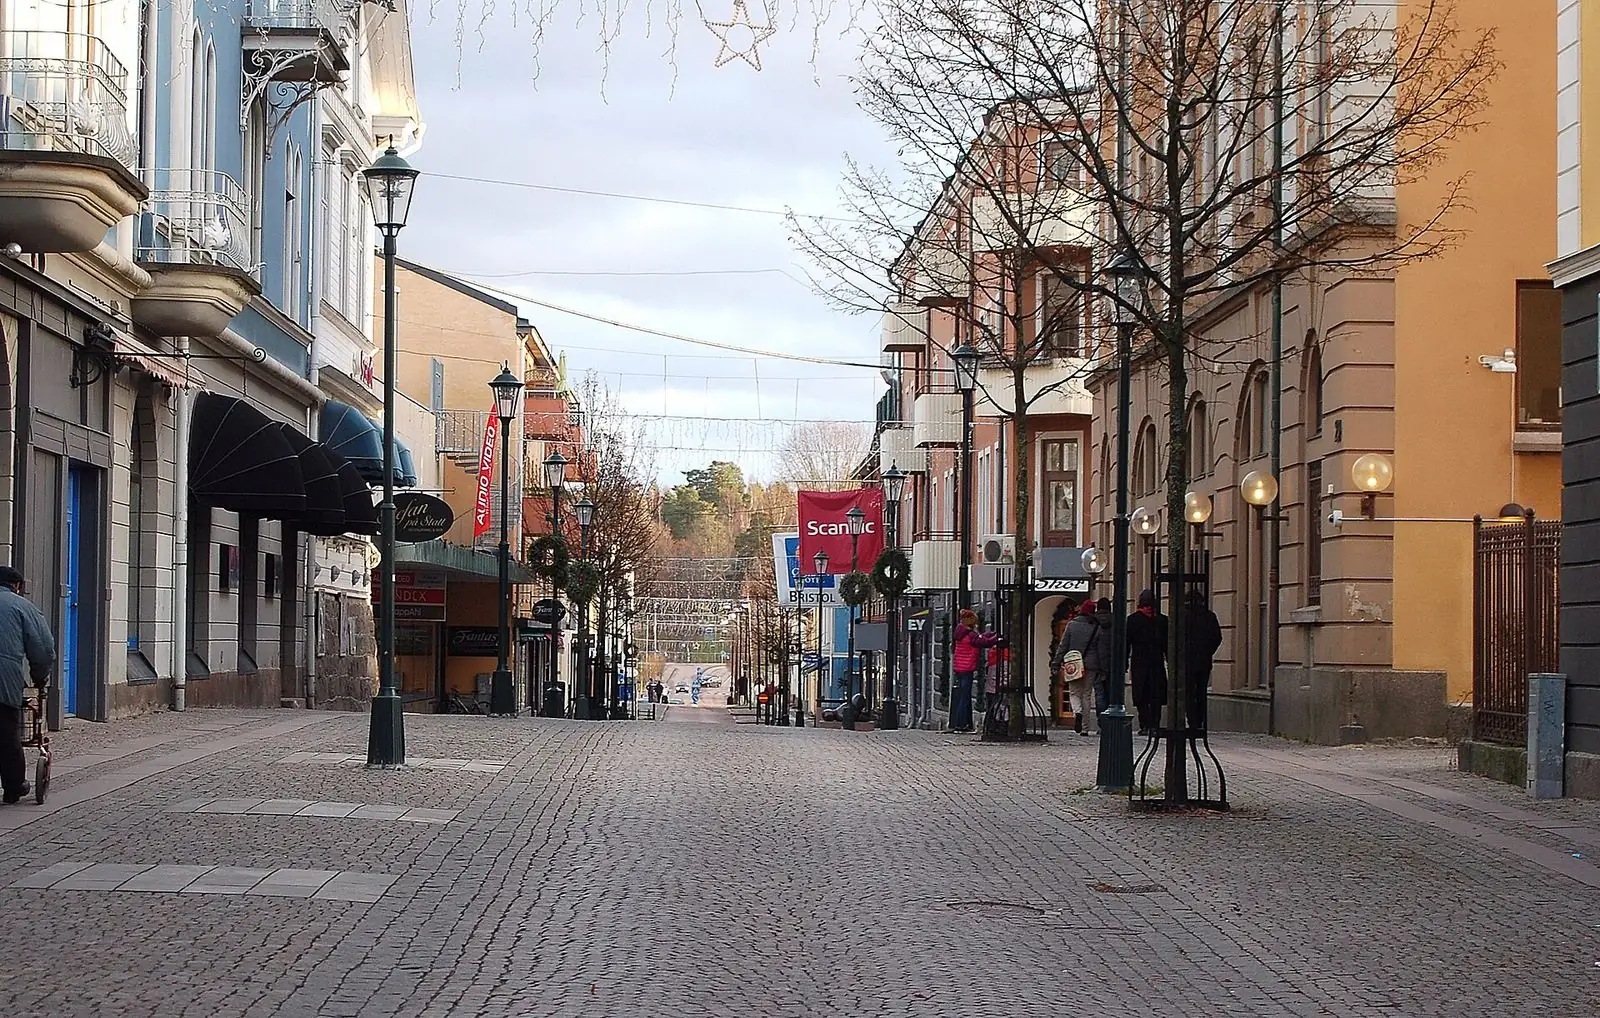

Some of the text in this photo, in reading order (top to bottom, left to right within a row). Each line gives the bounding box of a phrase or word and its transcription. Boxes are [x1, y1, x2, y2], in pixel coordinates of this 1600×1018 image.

[476, 427, 495, 525] AUDIO VIDEO
[807, 520, 875, 536] Scanic
[790, 590, 836, 602] BRISTOL
[908, 619, 926, 630] EY
